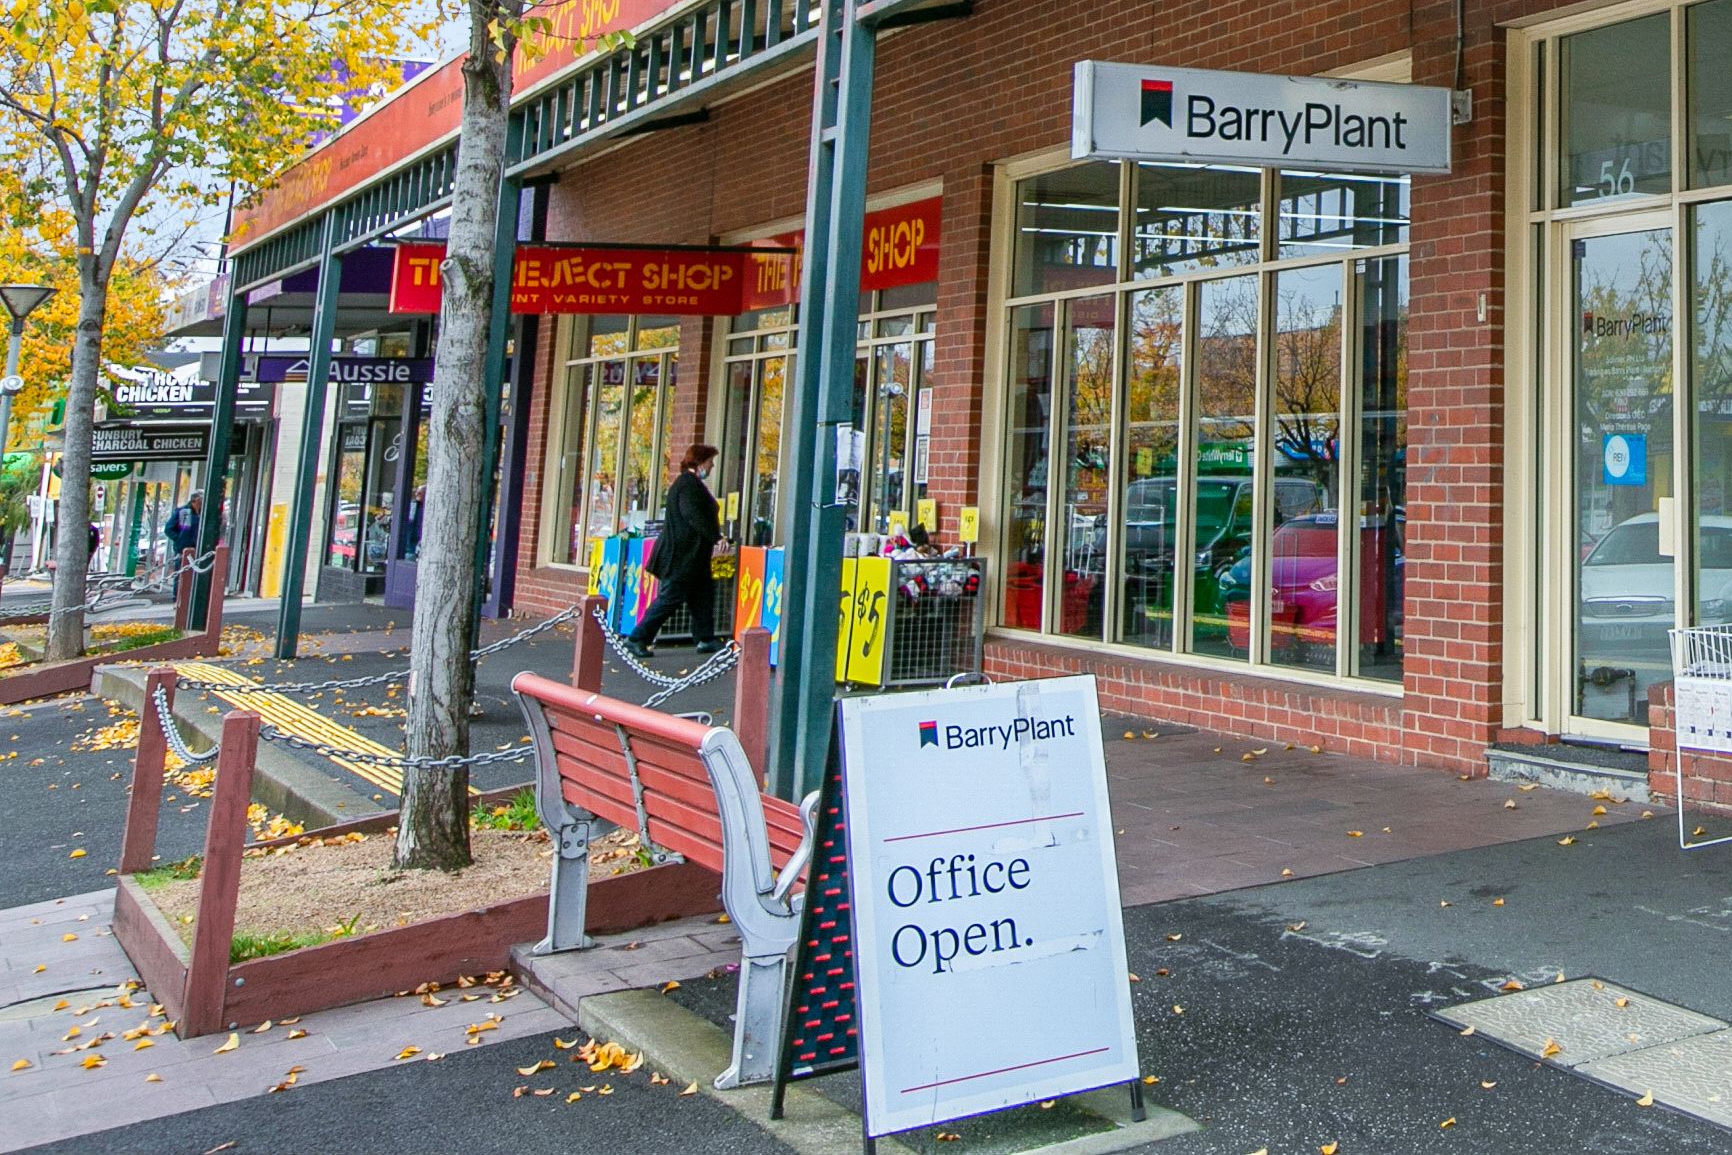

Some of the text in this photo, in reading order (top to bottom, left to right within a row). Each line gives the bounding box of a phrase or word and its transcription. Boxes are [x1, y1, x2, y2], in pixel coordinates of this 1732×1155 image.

[1187, 95, 1407, 155] BarryPlant
[1599, 157, 1635, 197] 56
[867, 218, 924, 274] SHOP
[642, 261, 733, 291] SHOP
[553, 294, 630, 305] VARIETY
[642, 295, 699, 306] STORE
[1596, 313, 1666, 341] BarryPlant
[329, 360, 410, 382] Aussie
[117, 386, 194, 403] CHICKEN
[153, 438, 203, 450] CHICKEN
[857, 580, 886, 658] $5
[945, 714, 1075, 751] BarryPlant
[888, 853, 1031, 909] Office
[891, 915, 1034, 975] Open.
